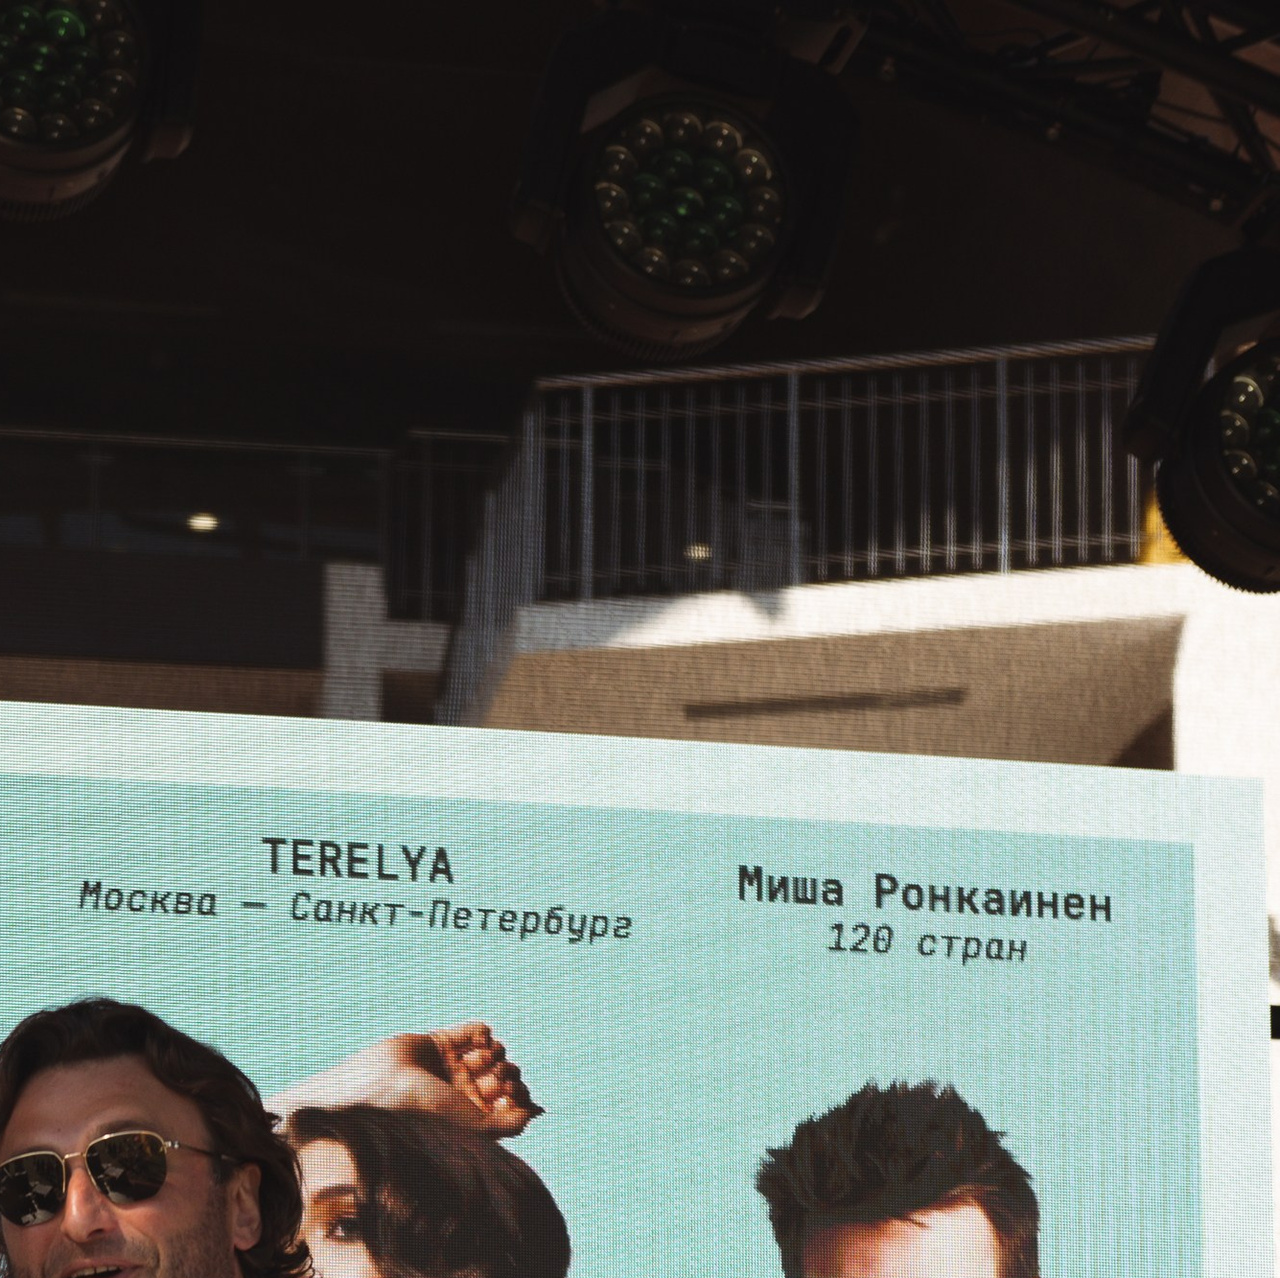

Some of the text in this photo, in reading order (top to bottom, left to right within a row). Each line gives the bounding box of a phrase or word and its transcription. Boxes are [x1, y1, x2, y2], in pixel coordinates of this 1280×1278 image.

[262, 836, 454, 884] TERELYA
[78, 880, 218, 918] Москва
[290, 890, 634, 942] Санкт-Петербург
[736, 864, 1114, 923] Миша Ронкаинен
[827, 923, 1028, 965] 120 стран
